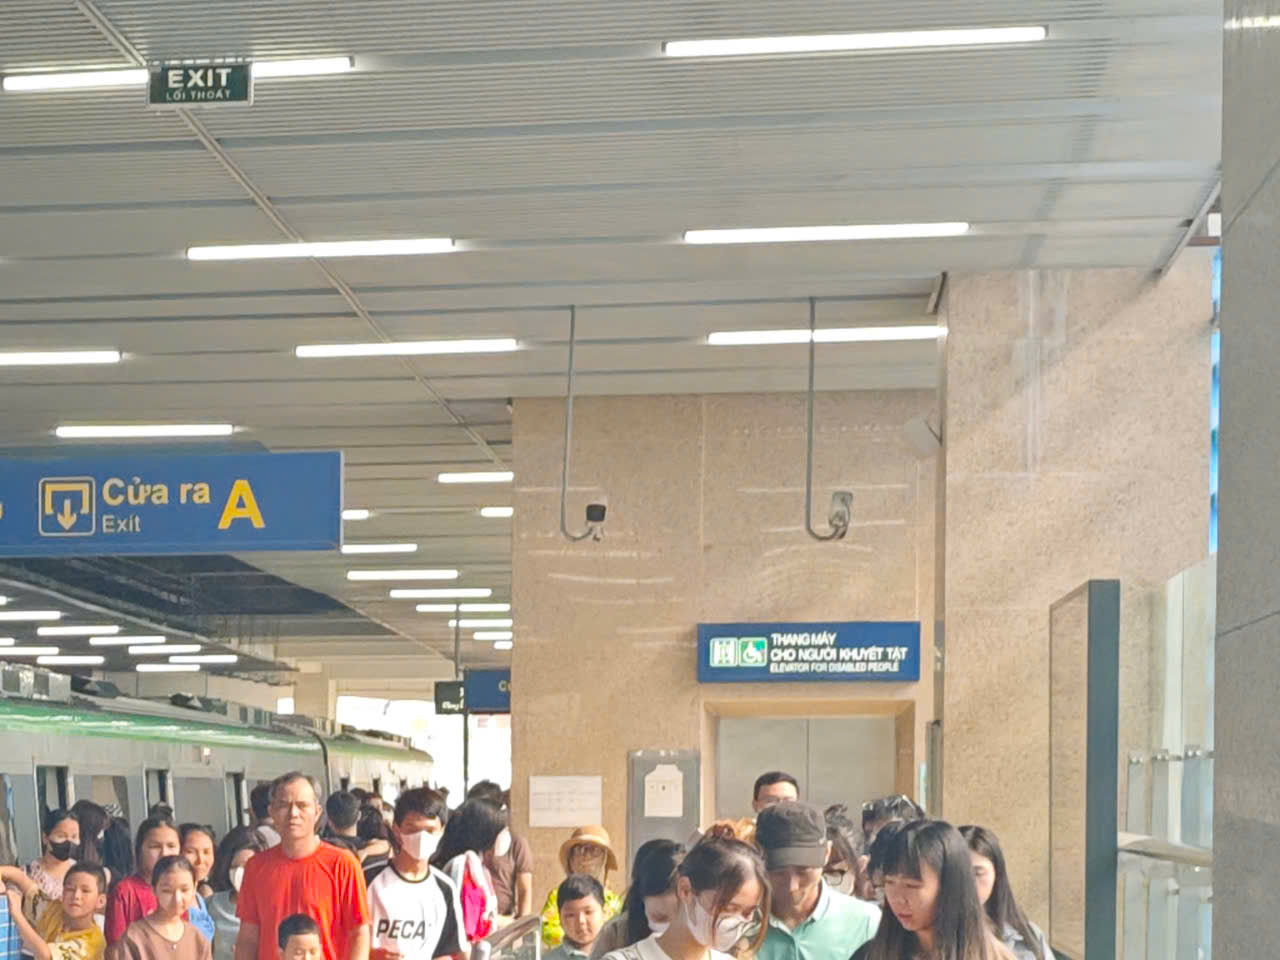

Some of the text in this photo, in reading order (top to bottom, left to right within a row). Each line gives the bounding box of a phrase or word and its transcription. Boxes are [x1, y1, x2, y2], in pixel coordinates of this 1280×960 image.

[167, 67, 232, 88] EXIT
[102, 476, 266, 530] Cửa ra A
[102, 514, 141, 533] Exit
[770, 630, 837, 646] THANG MÁY
[770, 648, 796, 661] CHO
[770, 661, 899, 673] ELEVATOR FOR DISABLED PEOPLE
